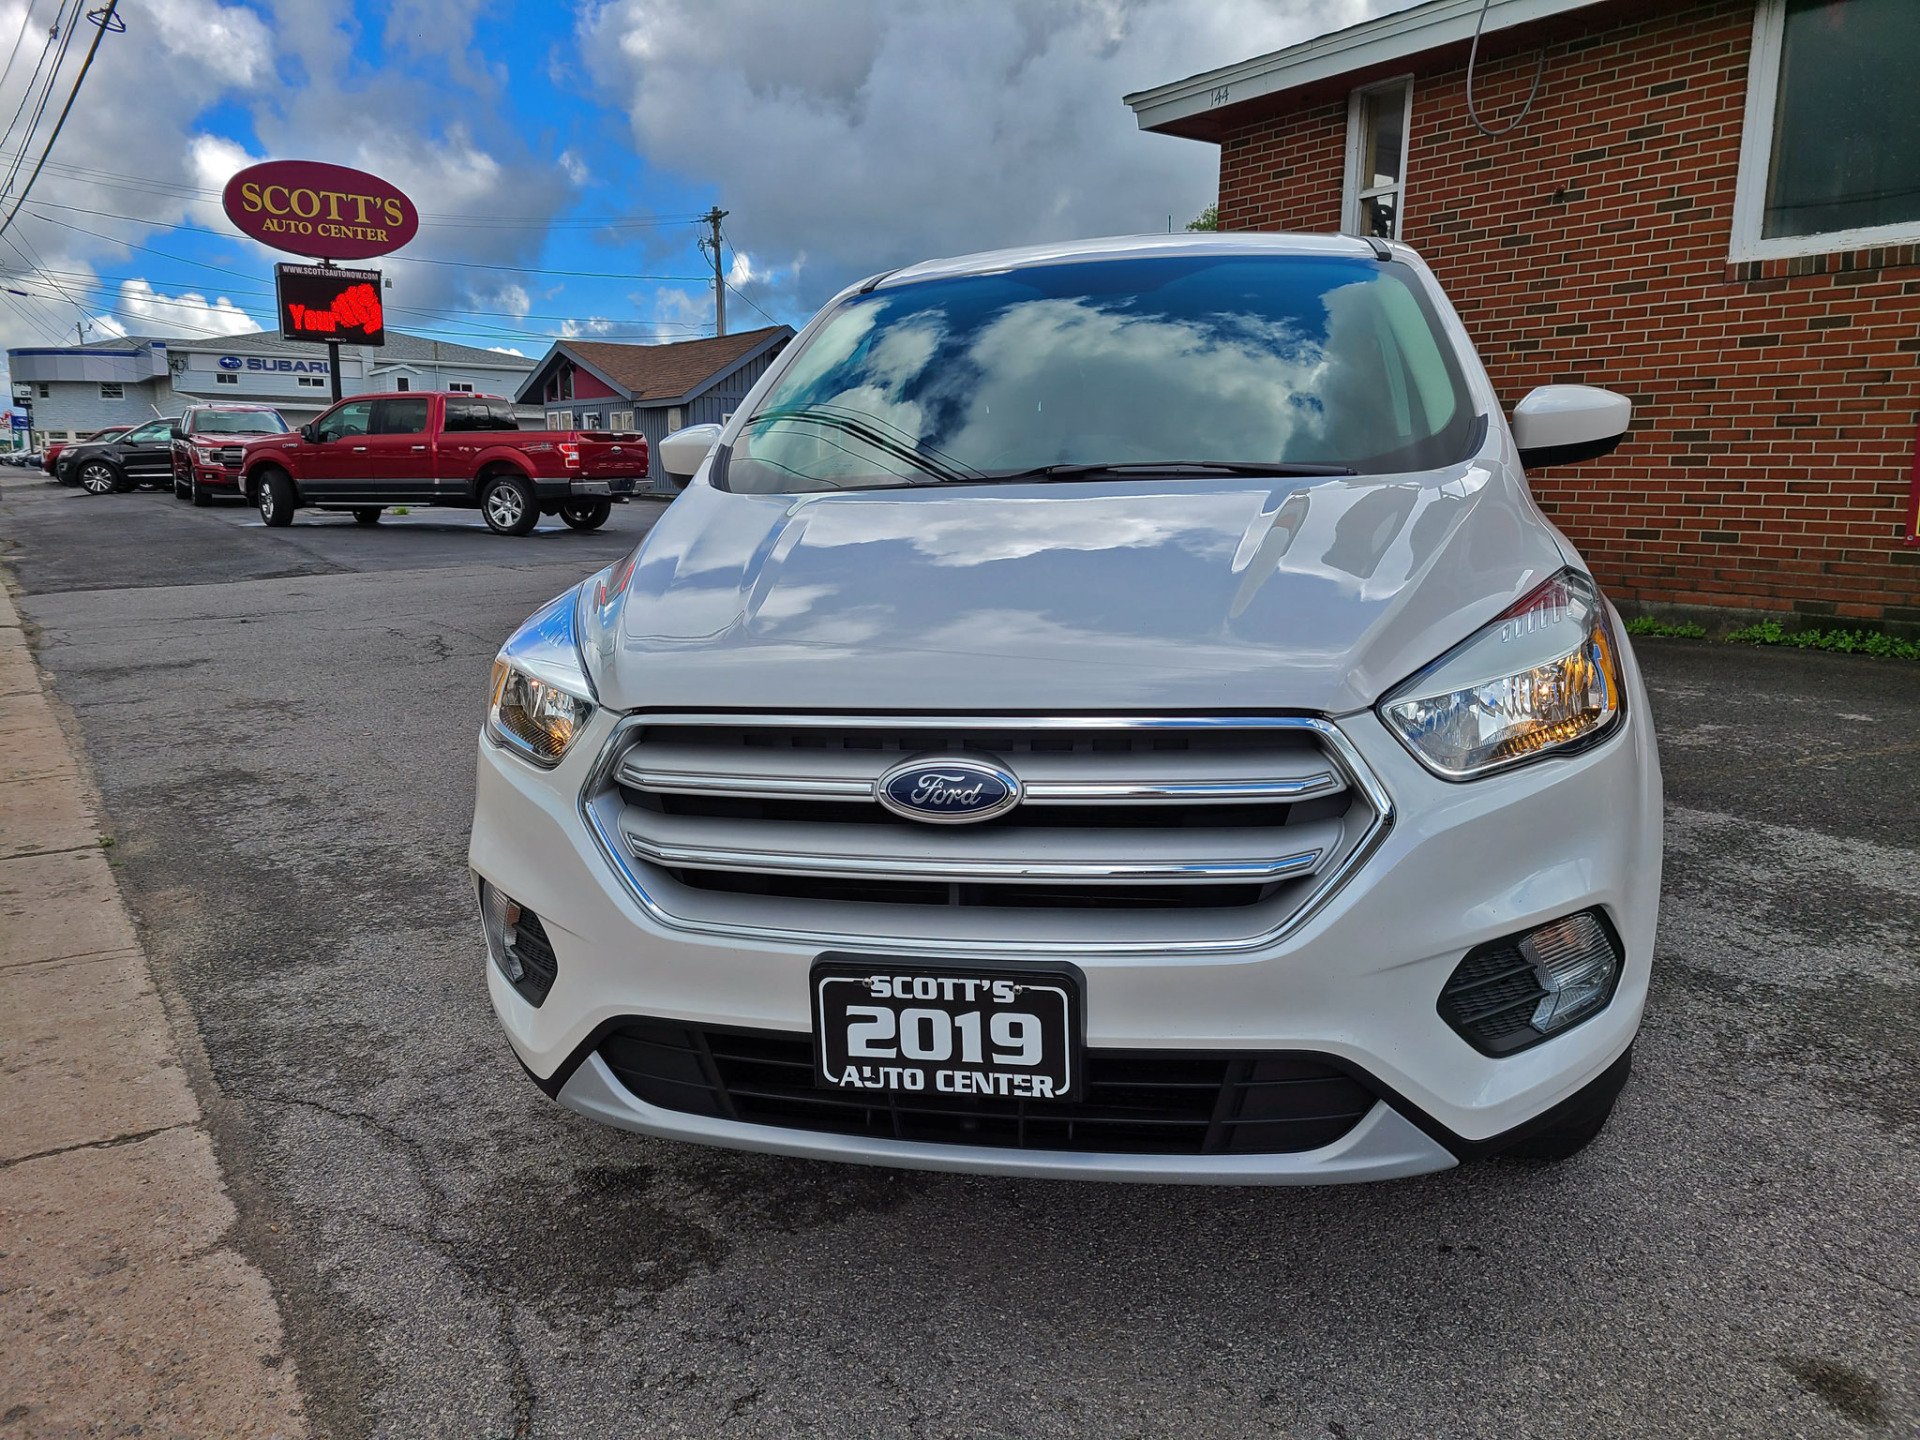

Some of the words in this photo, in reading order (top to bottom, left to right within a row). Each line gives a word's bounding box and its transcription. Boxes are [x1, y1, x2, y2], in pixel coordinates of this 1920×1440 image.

[1211, 86, 1229, 107] 144
[241, 182, 404, 227] SCOTT'S
[262, 218, 312, 235] AUTO
[318, 223, 389, 242] CENTER
[282, 265, 379, 281] WWW.SCOTTSAUTONOW.COM
[288, 303, 340, 332] Your
[910, 773, 983, 806] Ford
[870, 975, 1015, 1004] SCOTT'S
[846, 1005, 1043, 1066] 2019
[839, 1065, 925, 1091] AUTO
[936, 1069, 1054, 1098] CENTER
